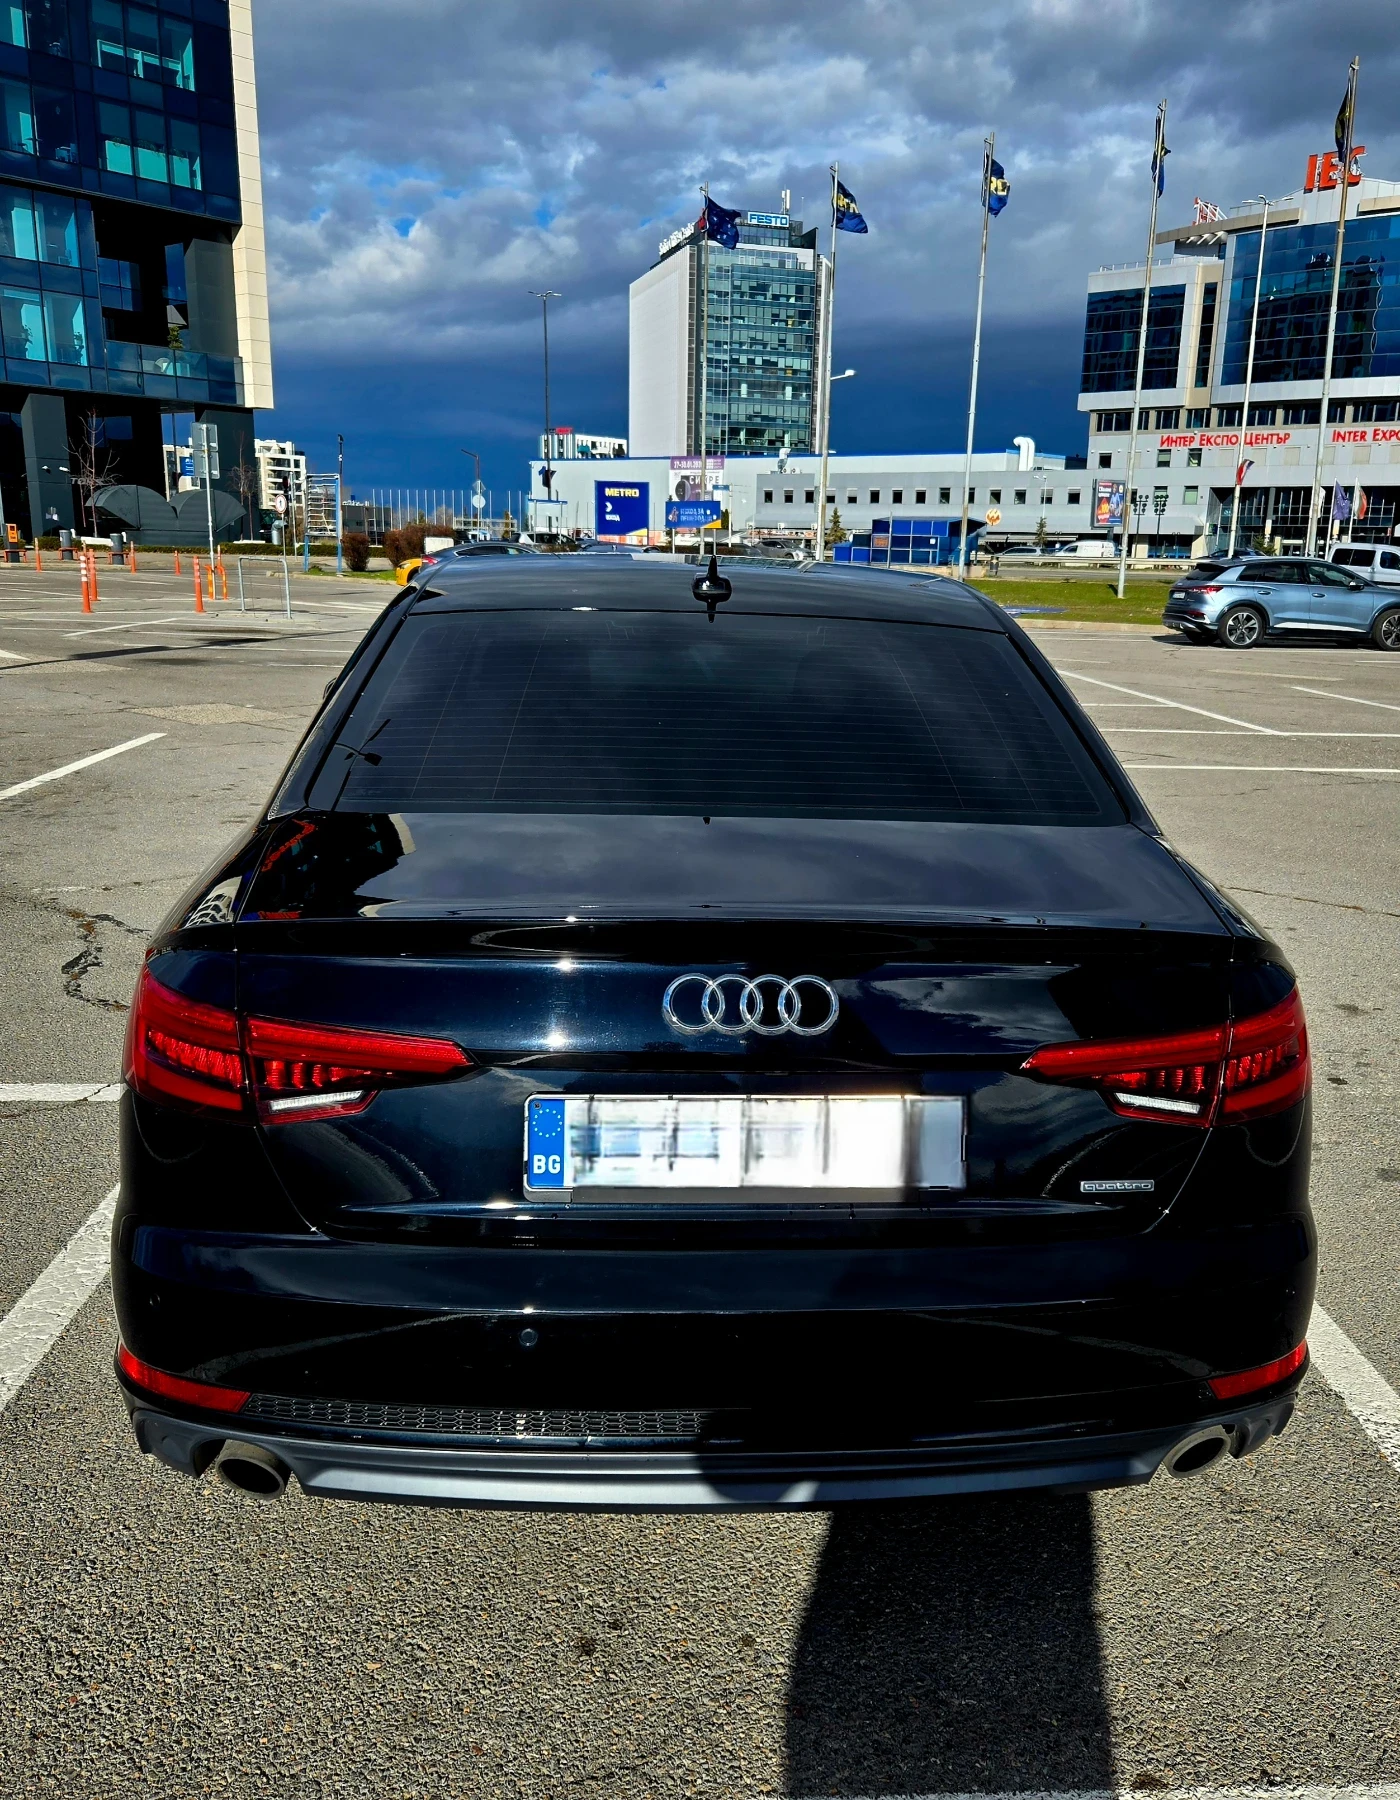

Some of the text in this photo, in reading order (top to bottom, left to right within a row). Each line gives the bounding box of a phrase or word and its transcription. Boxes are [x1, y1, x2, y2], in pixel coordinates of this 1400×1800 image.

[1304, 146, 1366, 191] IEC
[749, 213, 788, 226] FESTO
[1159, 432, 1291, 447] ИНТЕР ЕКСПО ЦЕНТЪР
[1332, 429, 1368, 442] INTER
[604, 487, 640, 498] METRO
[533, 1154, 561, 1174] BG
[1084, 1182, 1152, 1191] quattro
